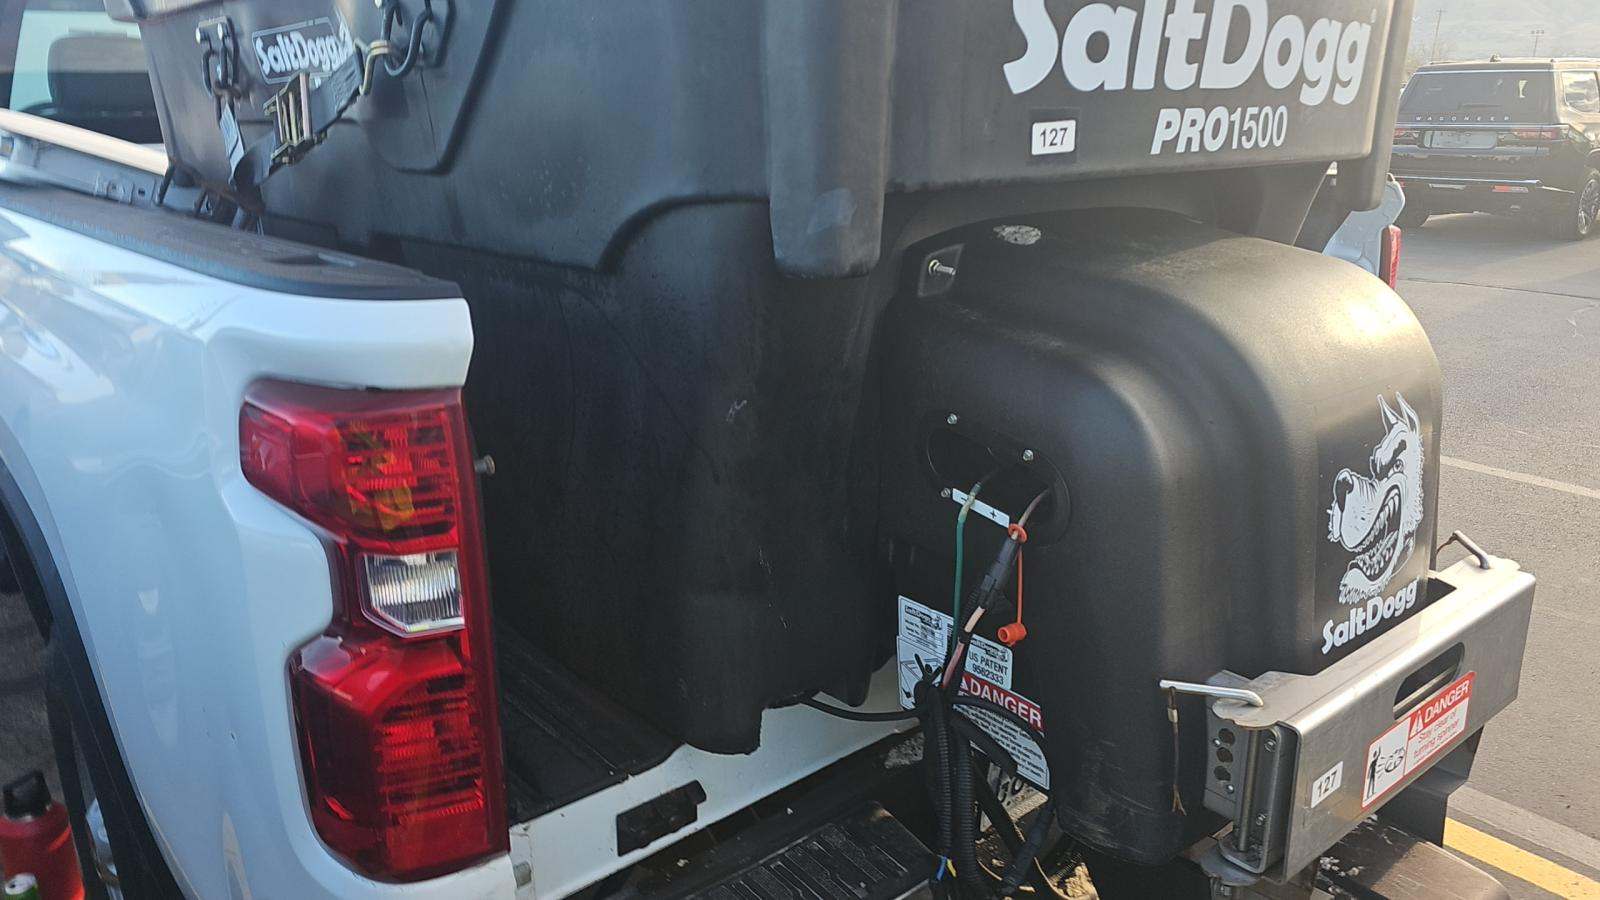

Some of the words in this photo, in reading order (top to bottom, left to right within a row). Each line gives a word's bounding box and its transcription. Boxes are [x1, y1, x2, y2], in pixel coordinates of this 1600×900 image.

[256, 31, 340, 75] SaltDogg
[1003, 0, 1371, 106] SaltDogg
[1039, 127, 1068, 148] 127
[1150, 105, 1288, 156] PRO1500
[1321, 580, 1418, 655] SaltDogg
[969, 651, 979, 663] US
[980, 656, 1008, 675] PATENT
[970, 678, 1042, 728] DANGER
[1424, 680, 1470, 723] DANGER
[1317, 769, 1337, 798] 127
